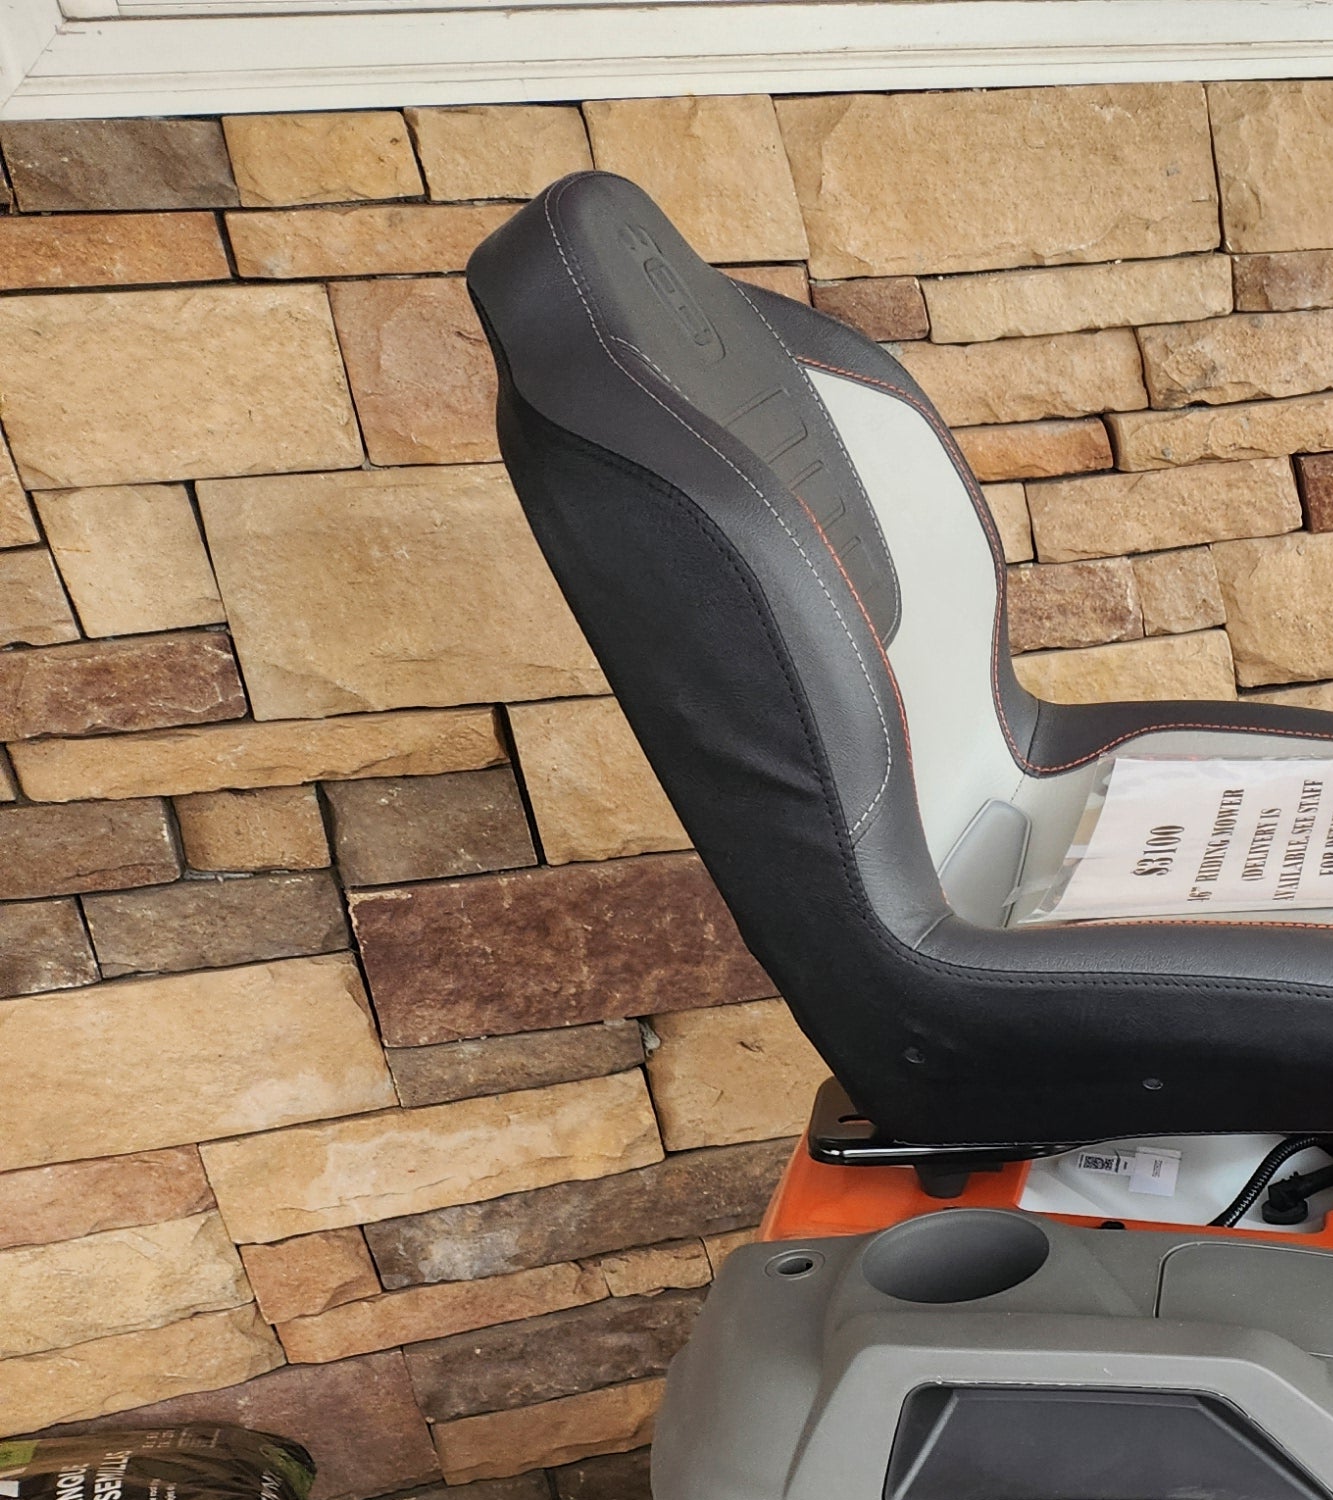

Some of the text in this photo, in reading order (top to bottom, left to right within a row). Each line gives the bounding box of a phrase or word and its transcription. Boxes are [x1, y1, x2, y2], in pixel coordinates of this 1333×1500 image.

[1211, 787, 1245, 836] MOWER
[1297, 779, 1324, 813] STAFF
[1241, 807, 1282, 882] (DELIVERY IS
[1291, 815, 1317, 835] SEE
[1130, 824, 1185, 877] $3100
[1194, 838, 1231, 883] RIDING
